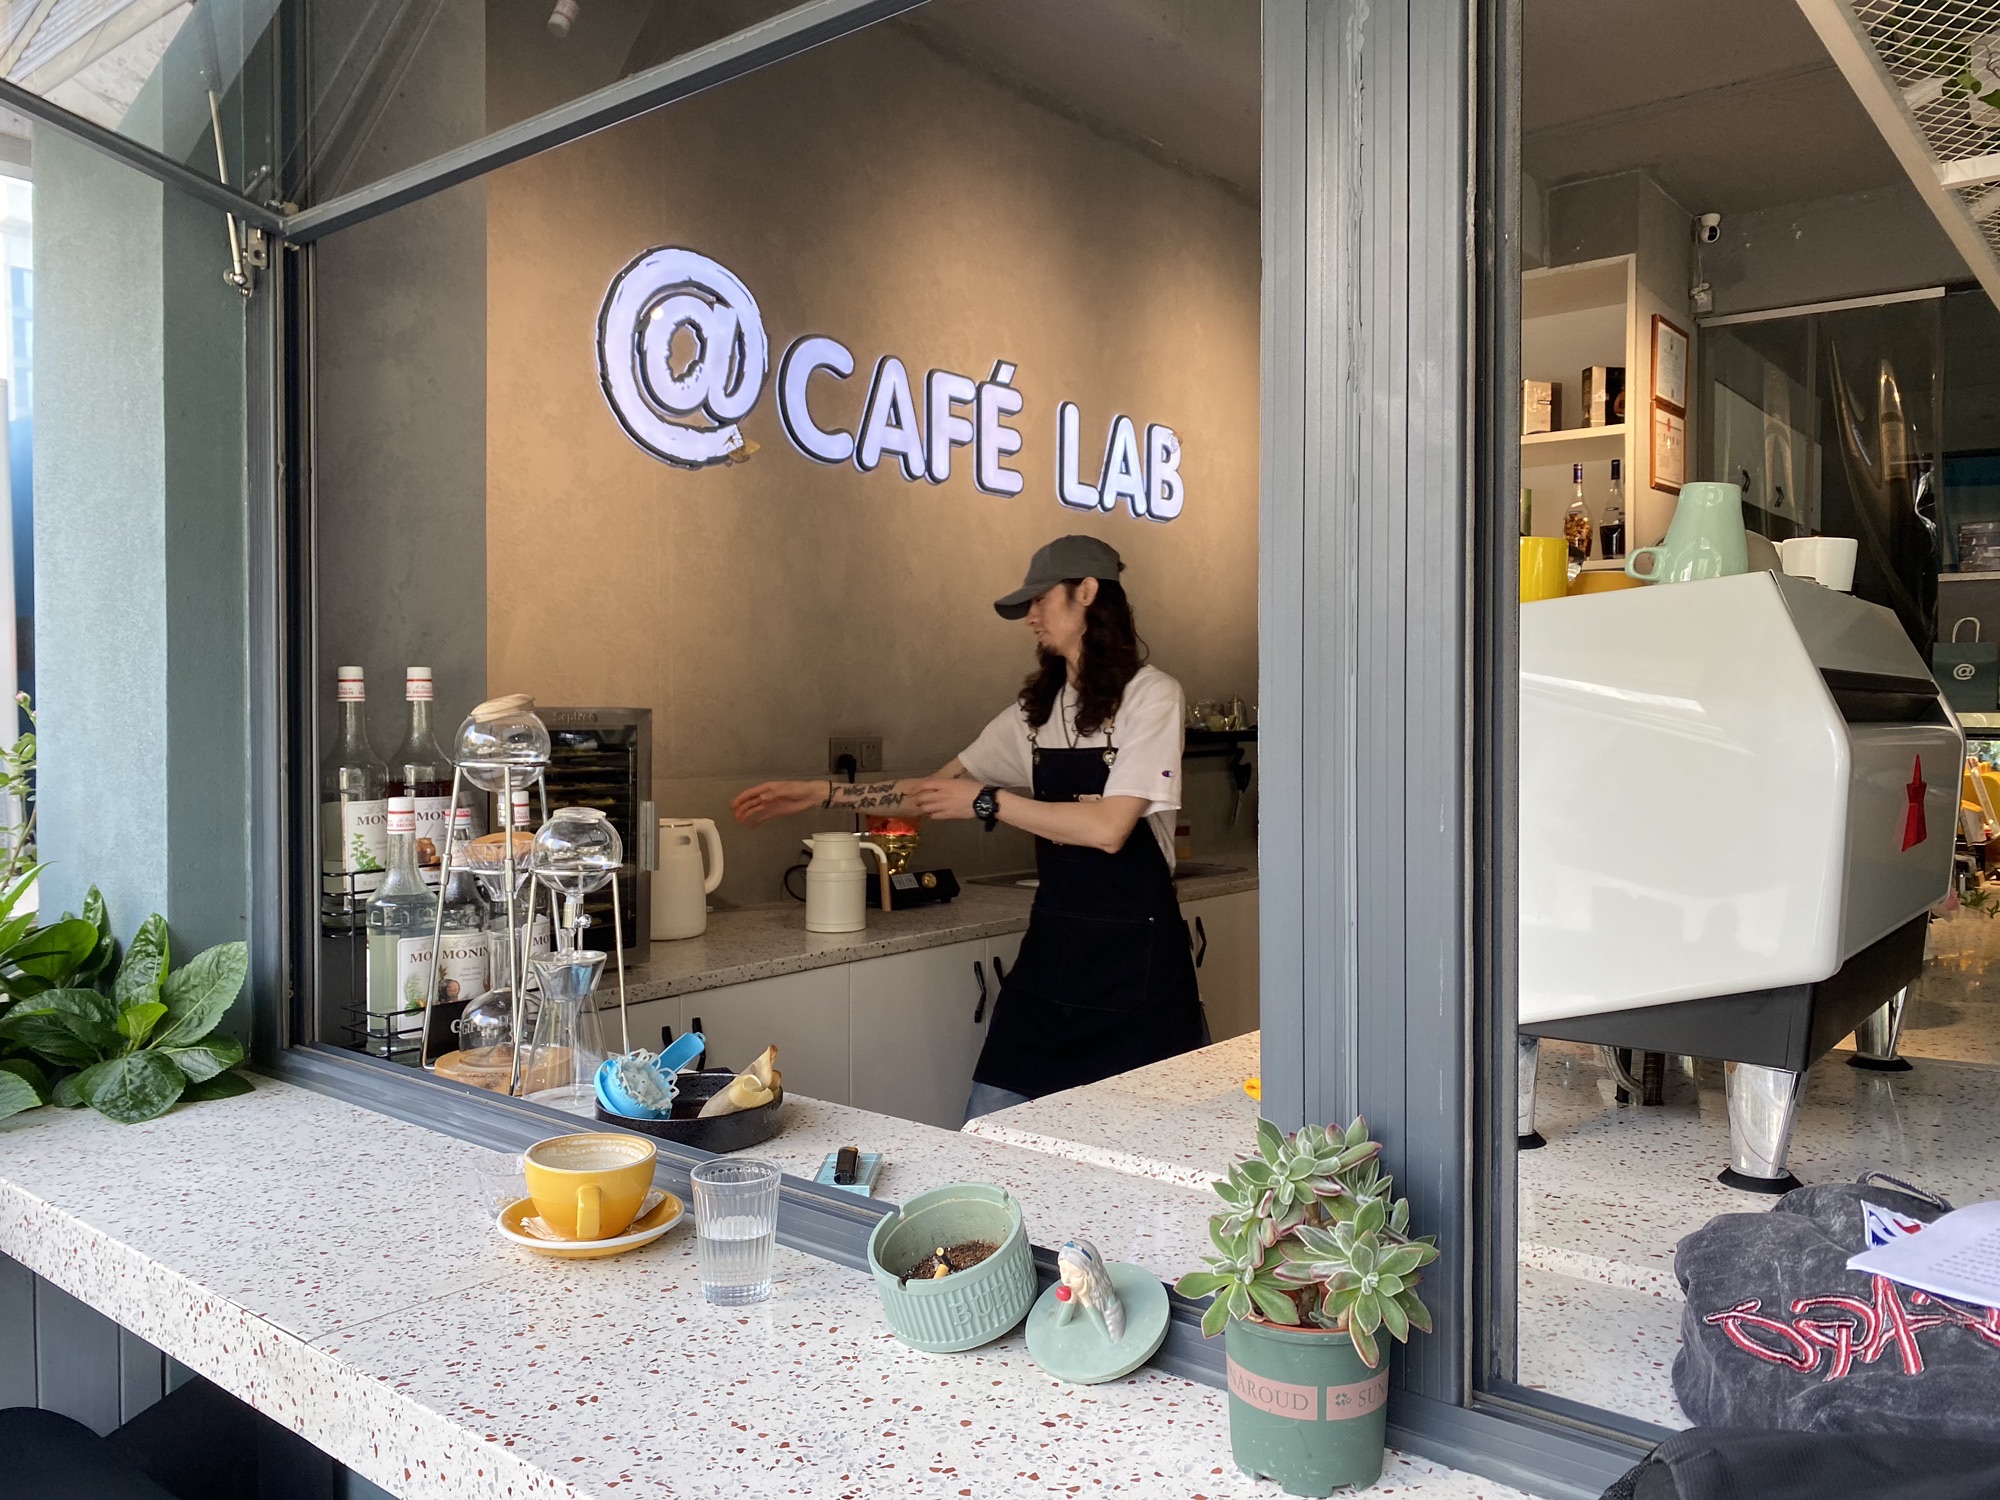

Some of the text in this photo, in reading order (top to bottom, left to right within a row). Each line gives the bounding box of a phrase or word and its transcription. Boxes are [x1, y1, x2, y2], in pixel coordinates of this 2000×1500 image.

[1056, 400, 1185, 523] LAB
[1953, 663, 1976, 681] @
[442, 946, 489, 959] MONIN
